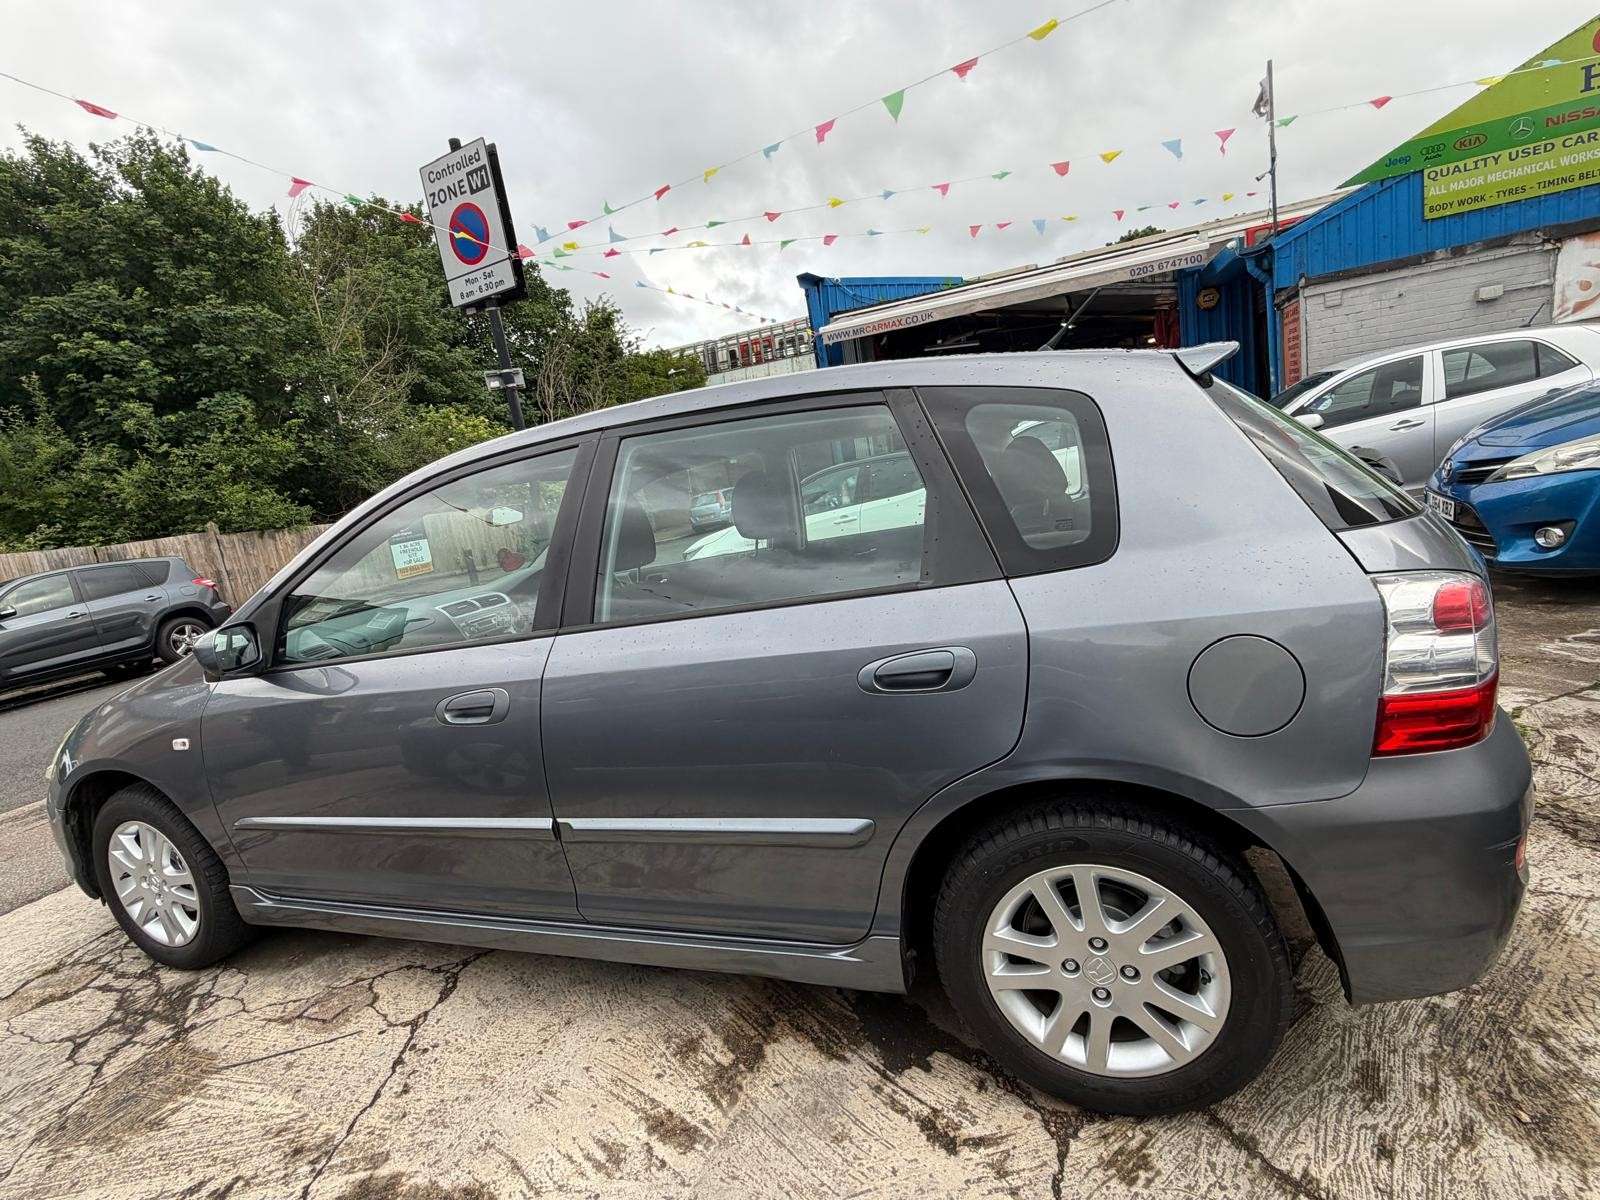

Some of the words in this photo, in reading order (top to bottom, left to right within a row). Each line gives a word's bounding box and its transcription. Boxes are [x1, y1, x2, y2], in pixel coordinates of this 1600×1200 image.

[1545, 107, 1600, 128] NISS
[427, 147, 481, 184] Controlled
[1385, 155, 1411, 168] Jeep
[1427, 154, 1501, 181] QUALITY
[1508, 142, 1556, 161] USED
[1429, 184, 1448, 197] ALL
[1450, 175, 1485, 192] MAJOR
[1487, 160, 1557, 184] MECHANICAL
[1560, 149, 1600, 167] WORKS
[428, 178, 468, 209] ZONE
[468, 168, 488, 190] W1
[1428, 201, 1455, 213] BODY
[1457, 193, 1487, 208] WORK
[1496, 185, 1528, 199] TYRES
[1536, 174, 1575, 190] TIMING
[1129, 264, 1155, 277] 0203
[1158, 254, 1203, 270] 6747100
[478, 281, 494, 294] 6.30
[826, 311, 935, 342] WWW.MRCARMAX.CO.UK
